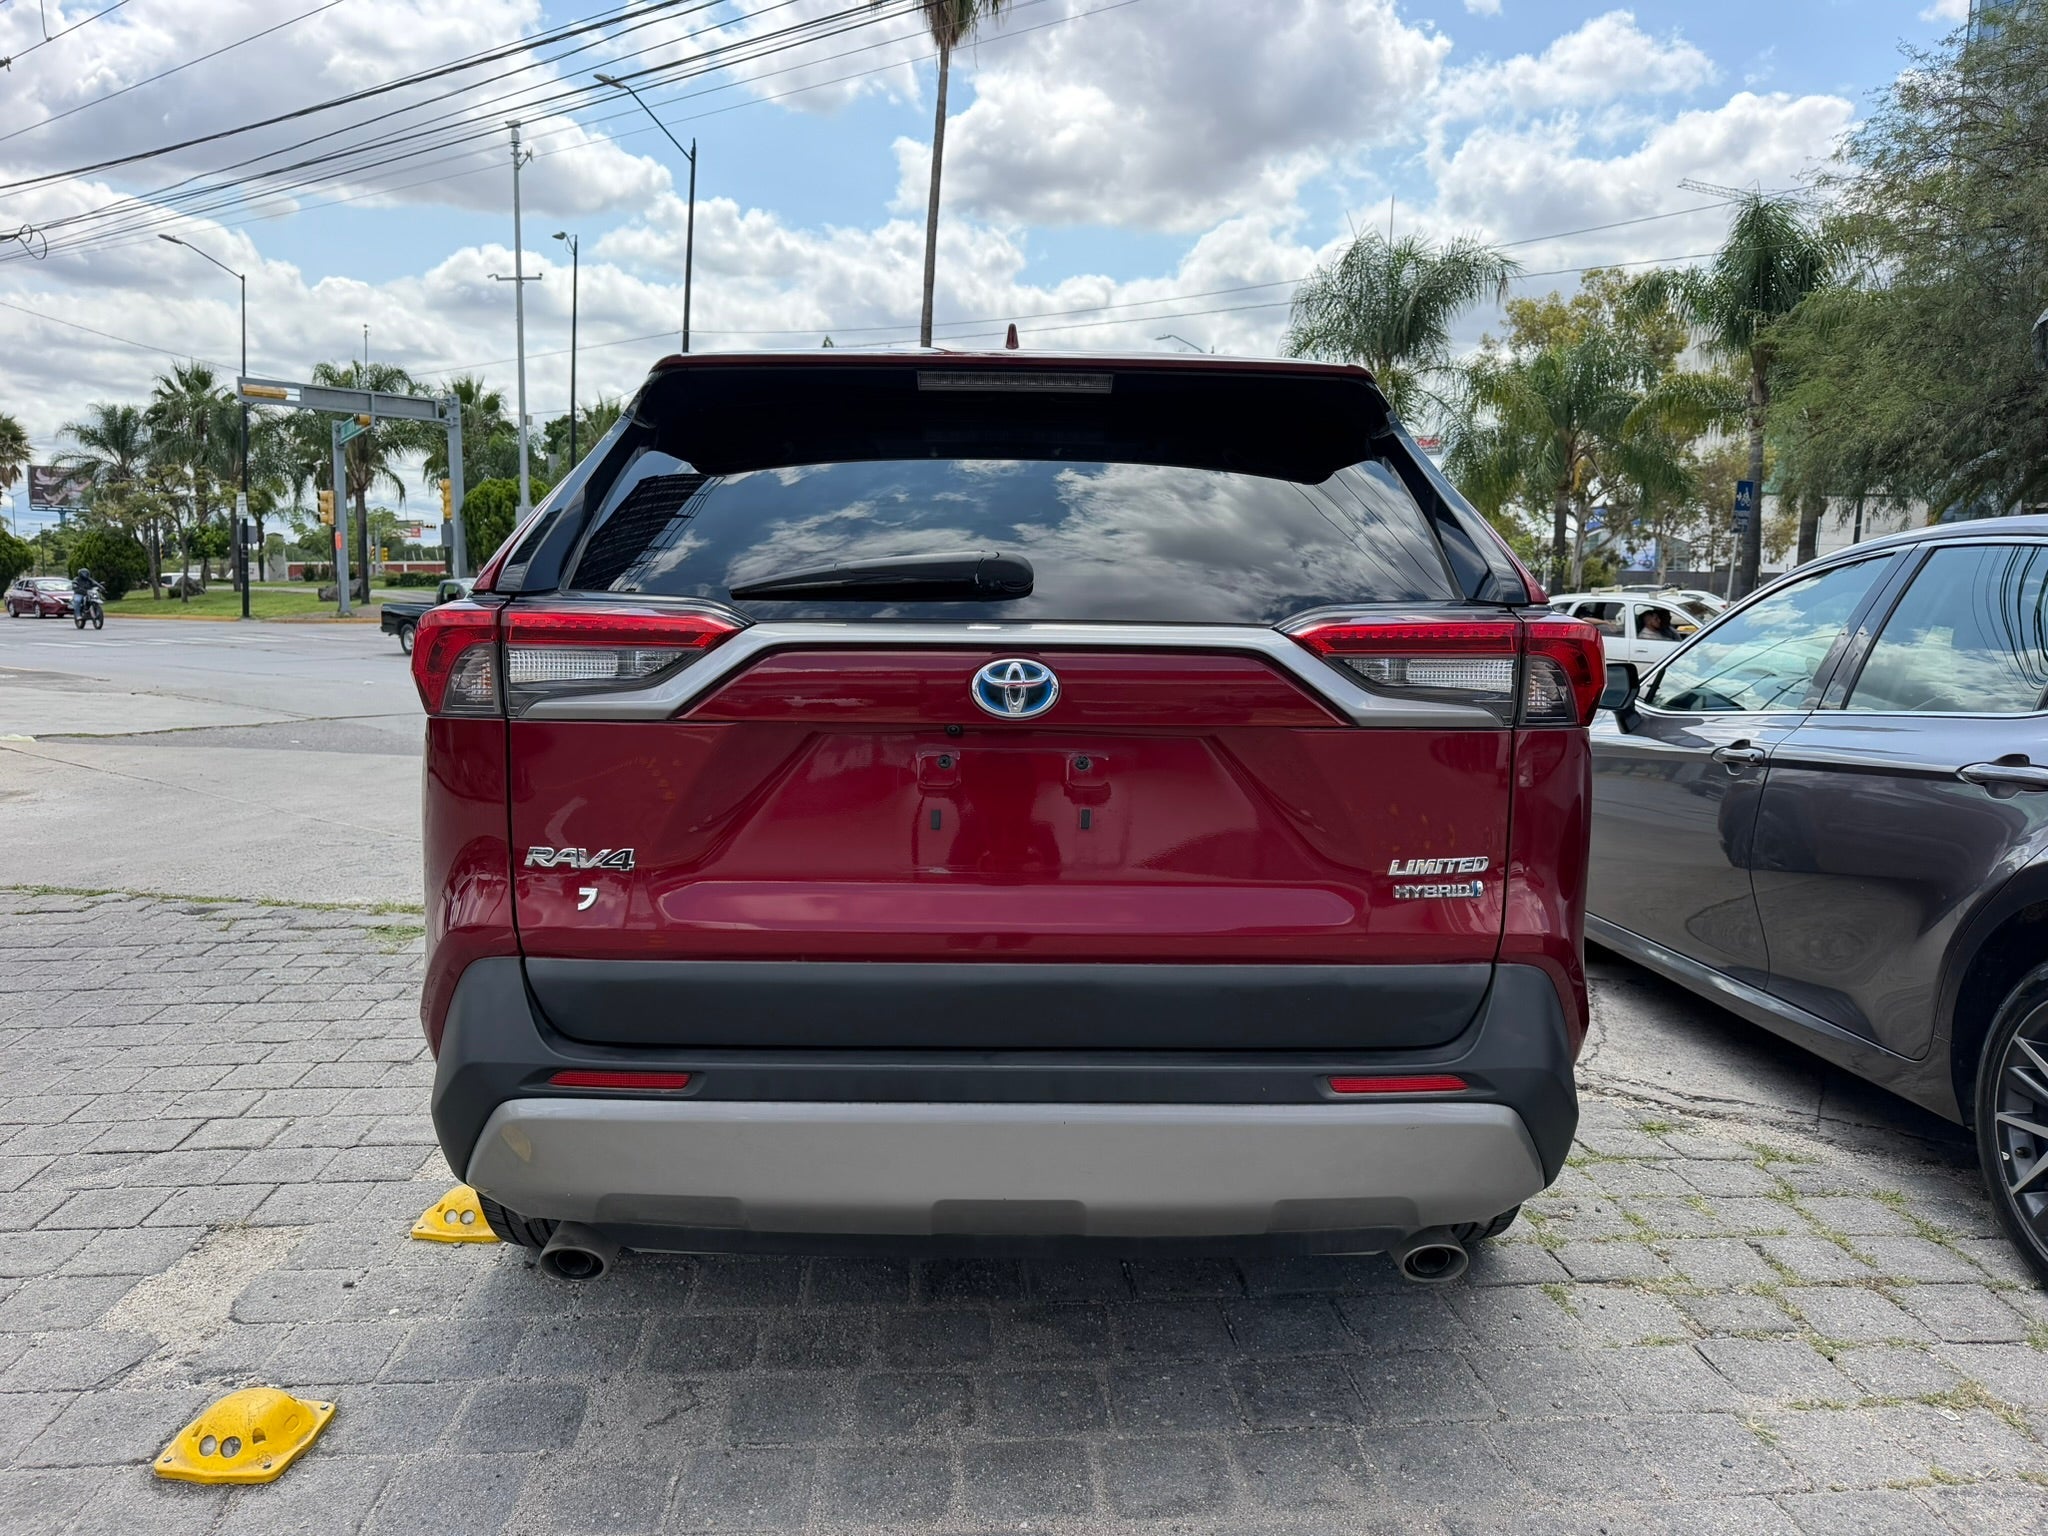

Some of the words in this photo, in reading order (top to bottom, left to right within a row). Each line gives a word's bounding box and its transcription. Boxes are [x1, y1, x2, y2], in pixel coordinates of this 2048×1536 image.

[524, 846, 635, 871] RAV4
[1388, 856, 1489, 876] LIMITED
[1393, 884, 1473, 899] HYBRID
